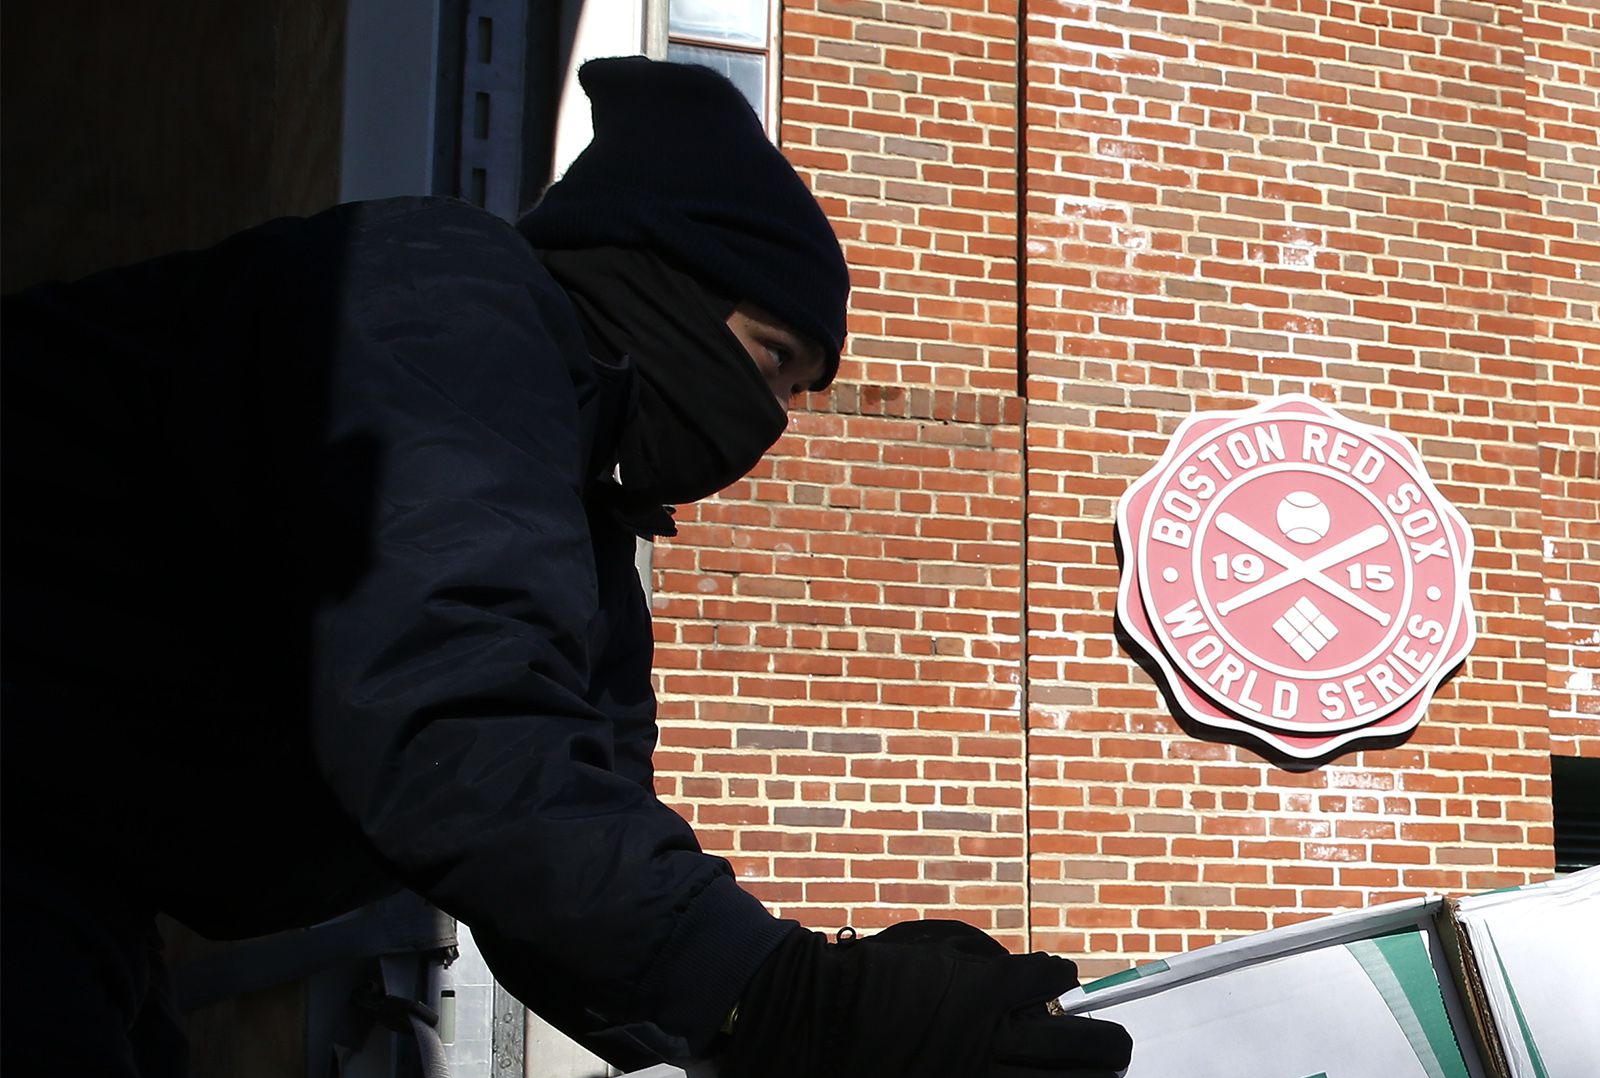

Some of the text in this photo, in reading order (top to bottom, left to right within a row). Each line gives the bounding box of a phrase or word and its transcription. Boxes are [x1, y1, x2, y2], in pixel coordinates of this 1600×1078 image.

[1152, 424, 1450, 563] BOSTON RED SOX
[1212, 553, 1394, 591] 19 15
[1164, 599, 1445, 721] WORLD SERIES
